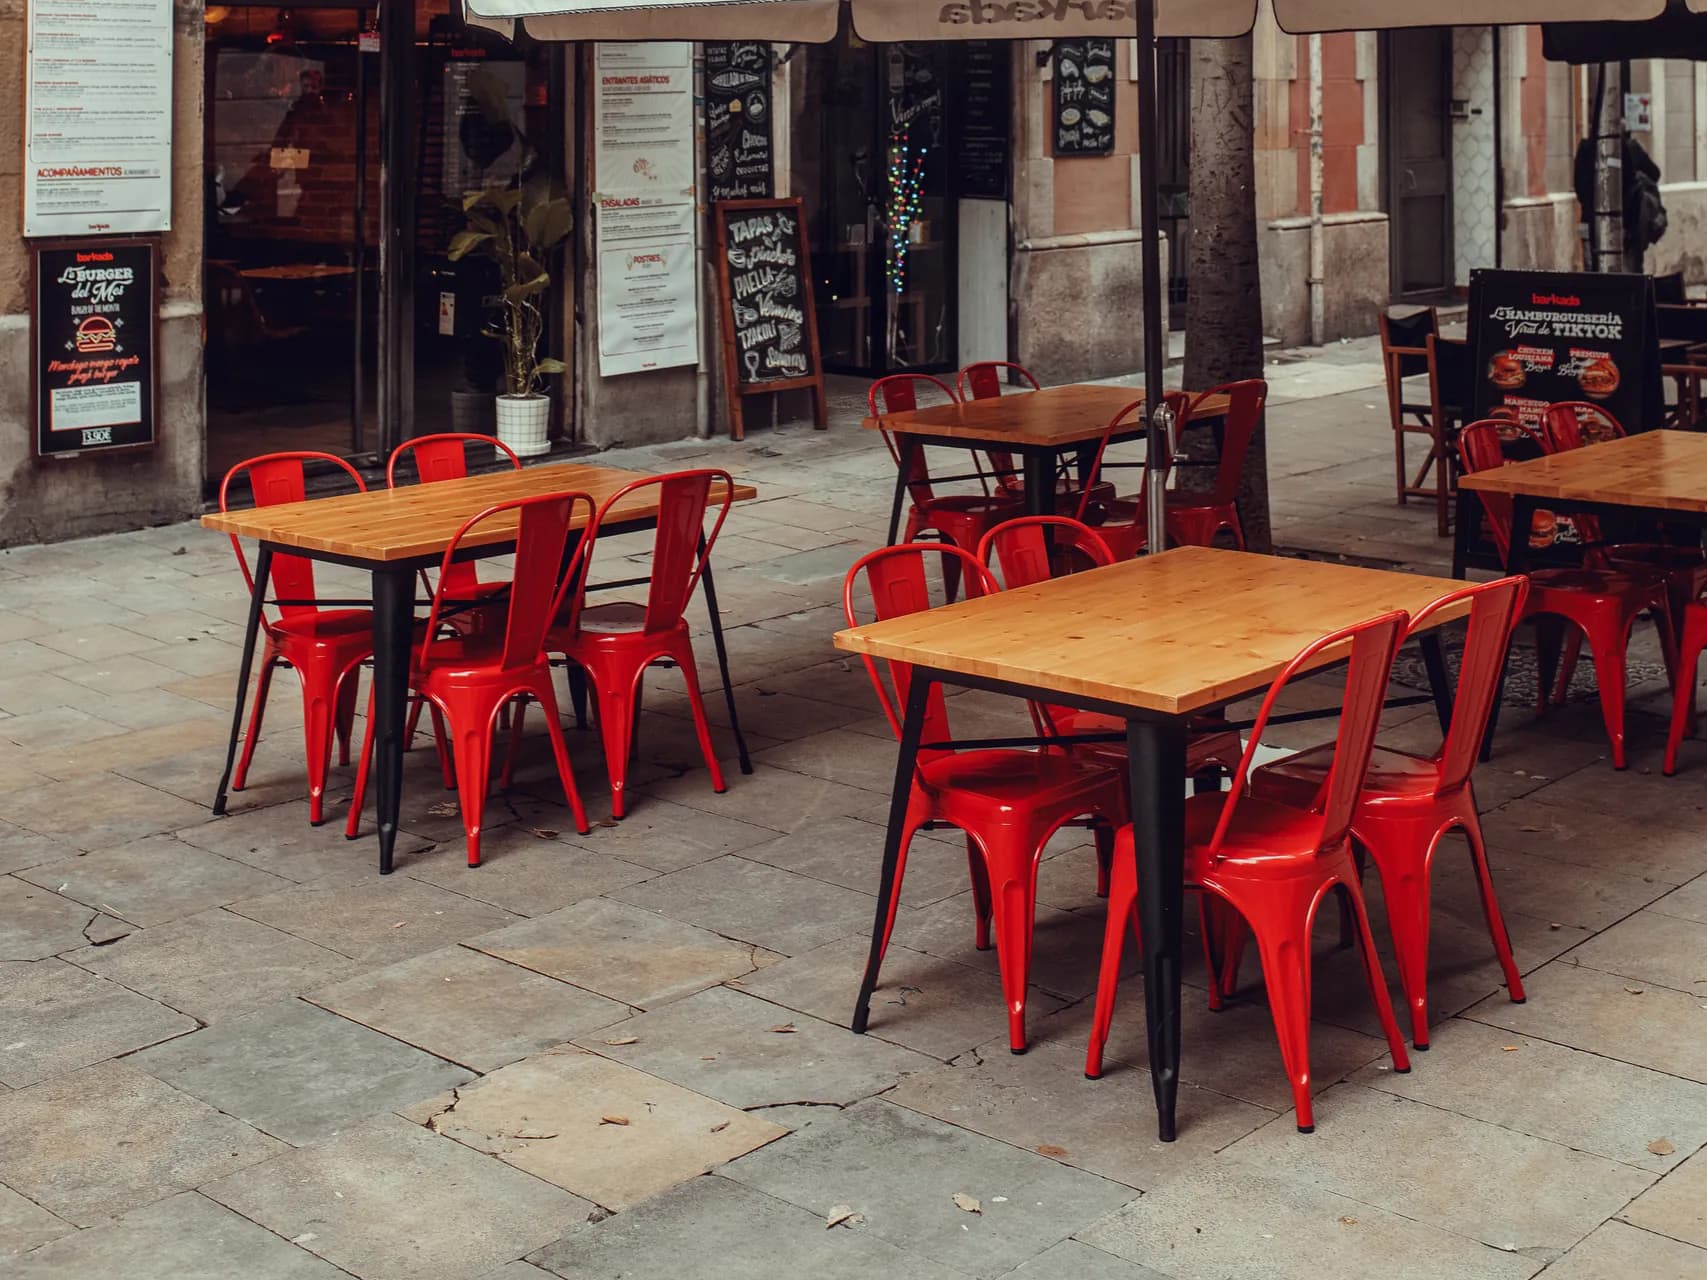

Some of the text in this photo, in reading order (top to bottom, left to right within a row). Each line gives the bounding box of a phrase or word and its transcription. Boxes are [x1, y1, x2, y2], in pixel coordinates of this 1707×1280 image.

[37, 166, 122, 178] ACOMPAÑAMIENTOS
[728, 215, 774, 244] TAPAS
[76, 267, 134, 281] BURGER
[71, 282, 90, 298] del
[1505, 310, 1622, 325] HAMBURGUESERÍA
[1538, 322, 1551, 335] de
[1552, 322, 1622, 339] TIKTOK
